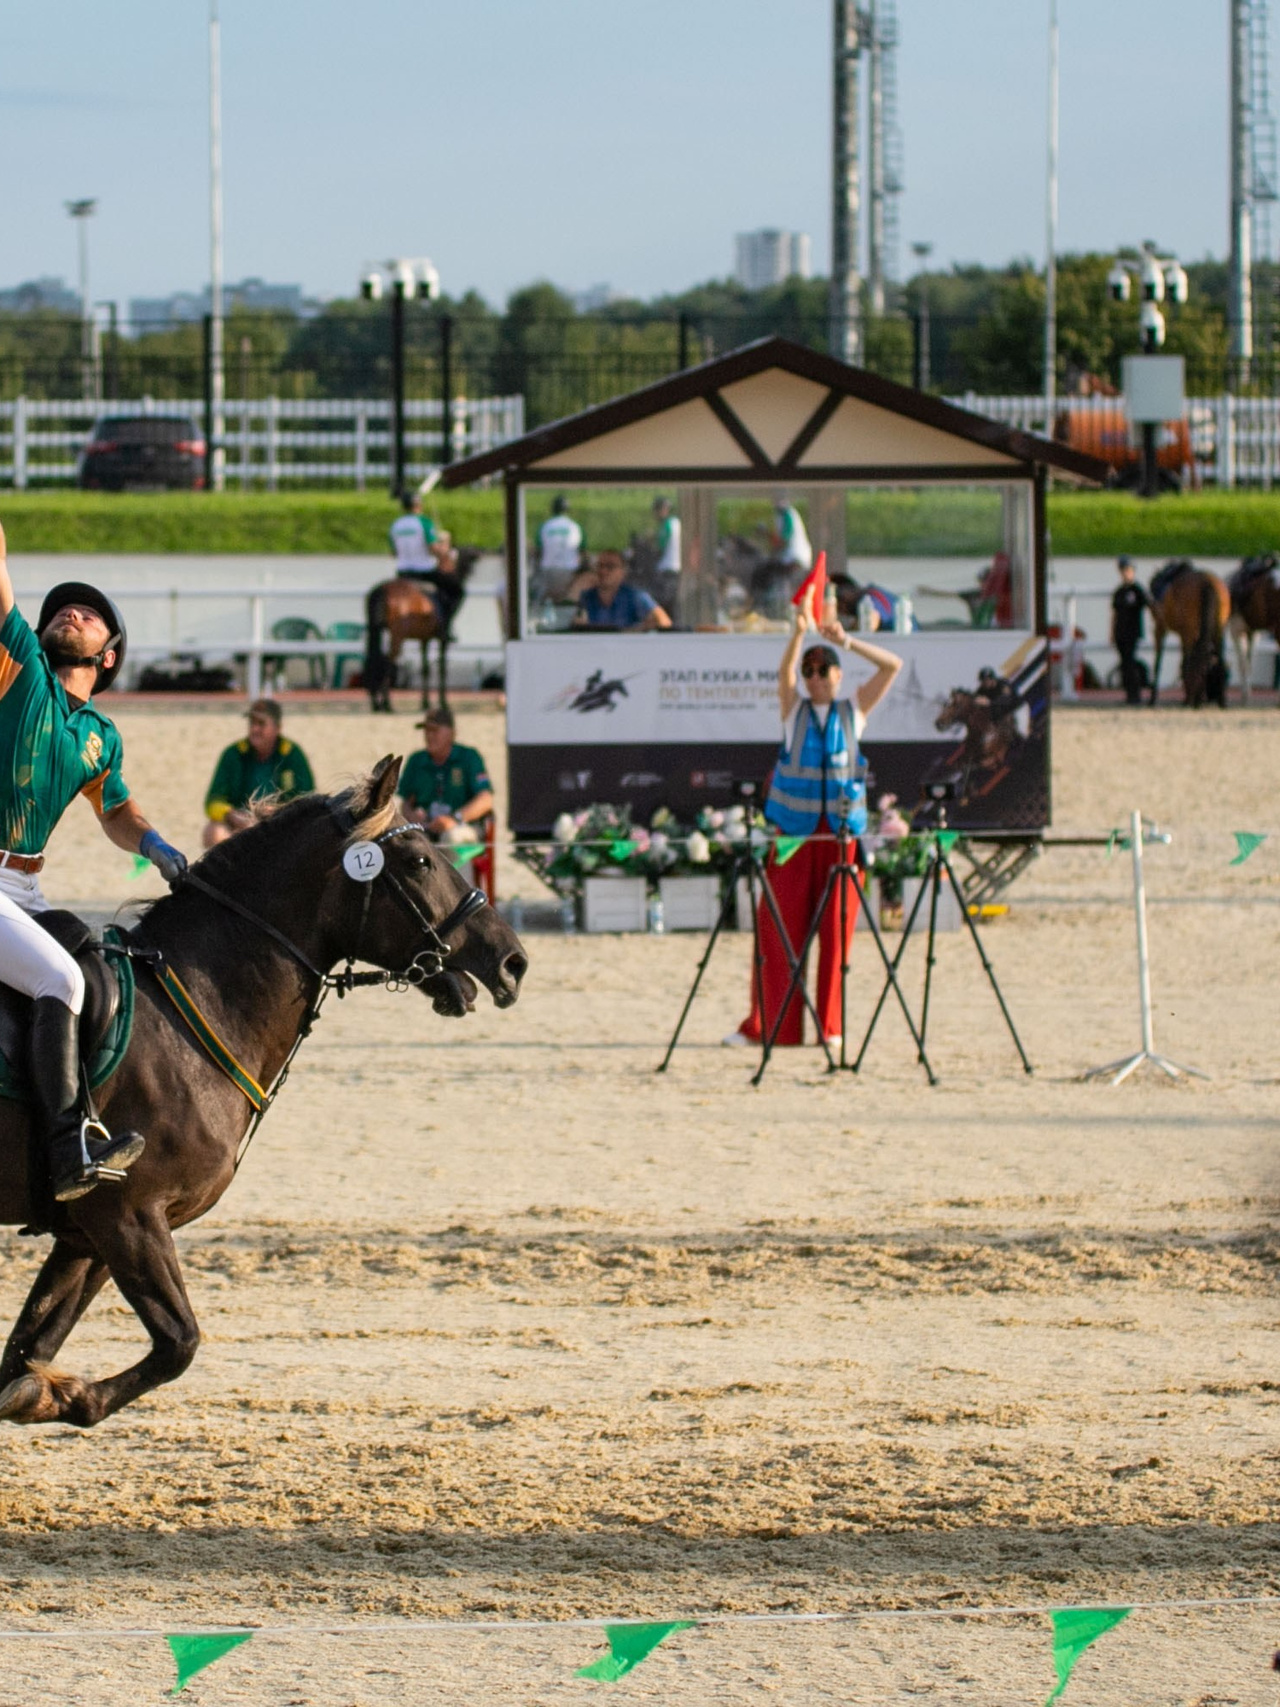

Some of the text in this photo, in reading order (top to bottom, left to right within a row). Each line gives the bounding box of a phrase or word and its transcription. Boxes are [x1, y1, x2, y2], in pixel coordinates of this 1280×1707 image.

[660, 670, 780, 683] ЭТАП КУБКА МИ
[660, 686, 681, 700] ПО
[354, 851, 375, 869] 12
